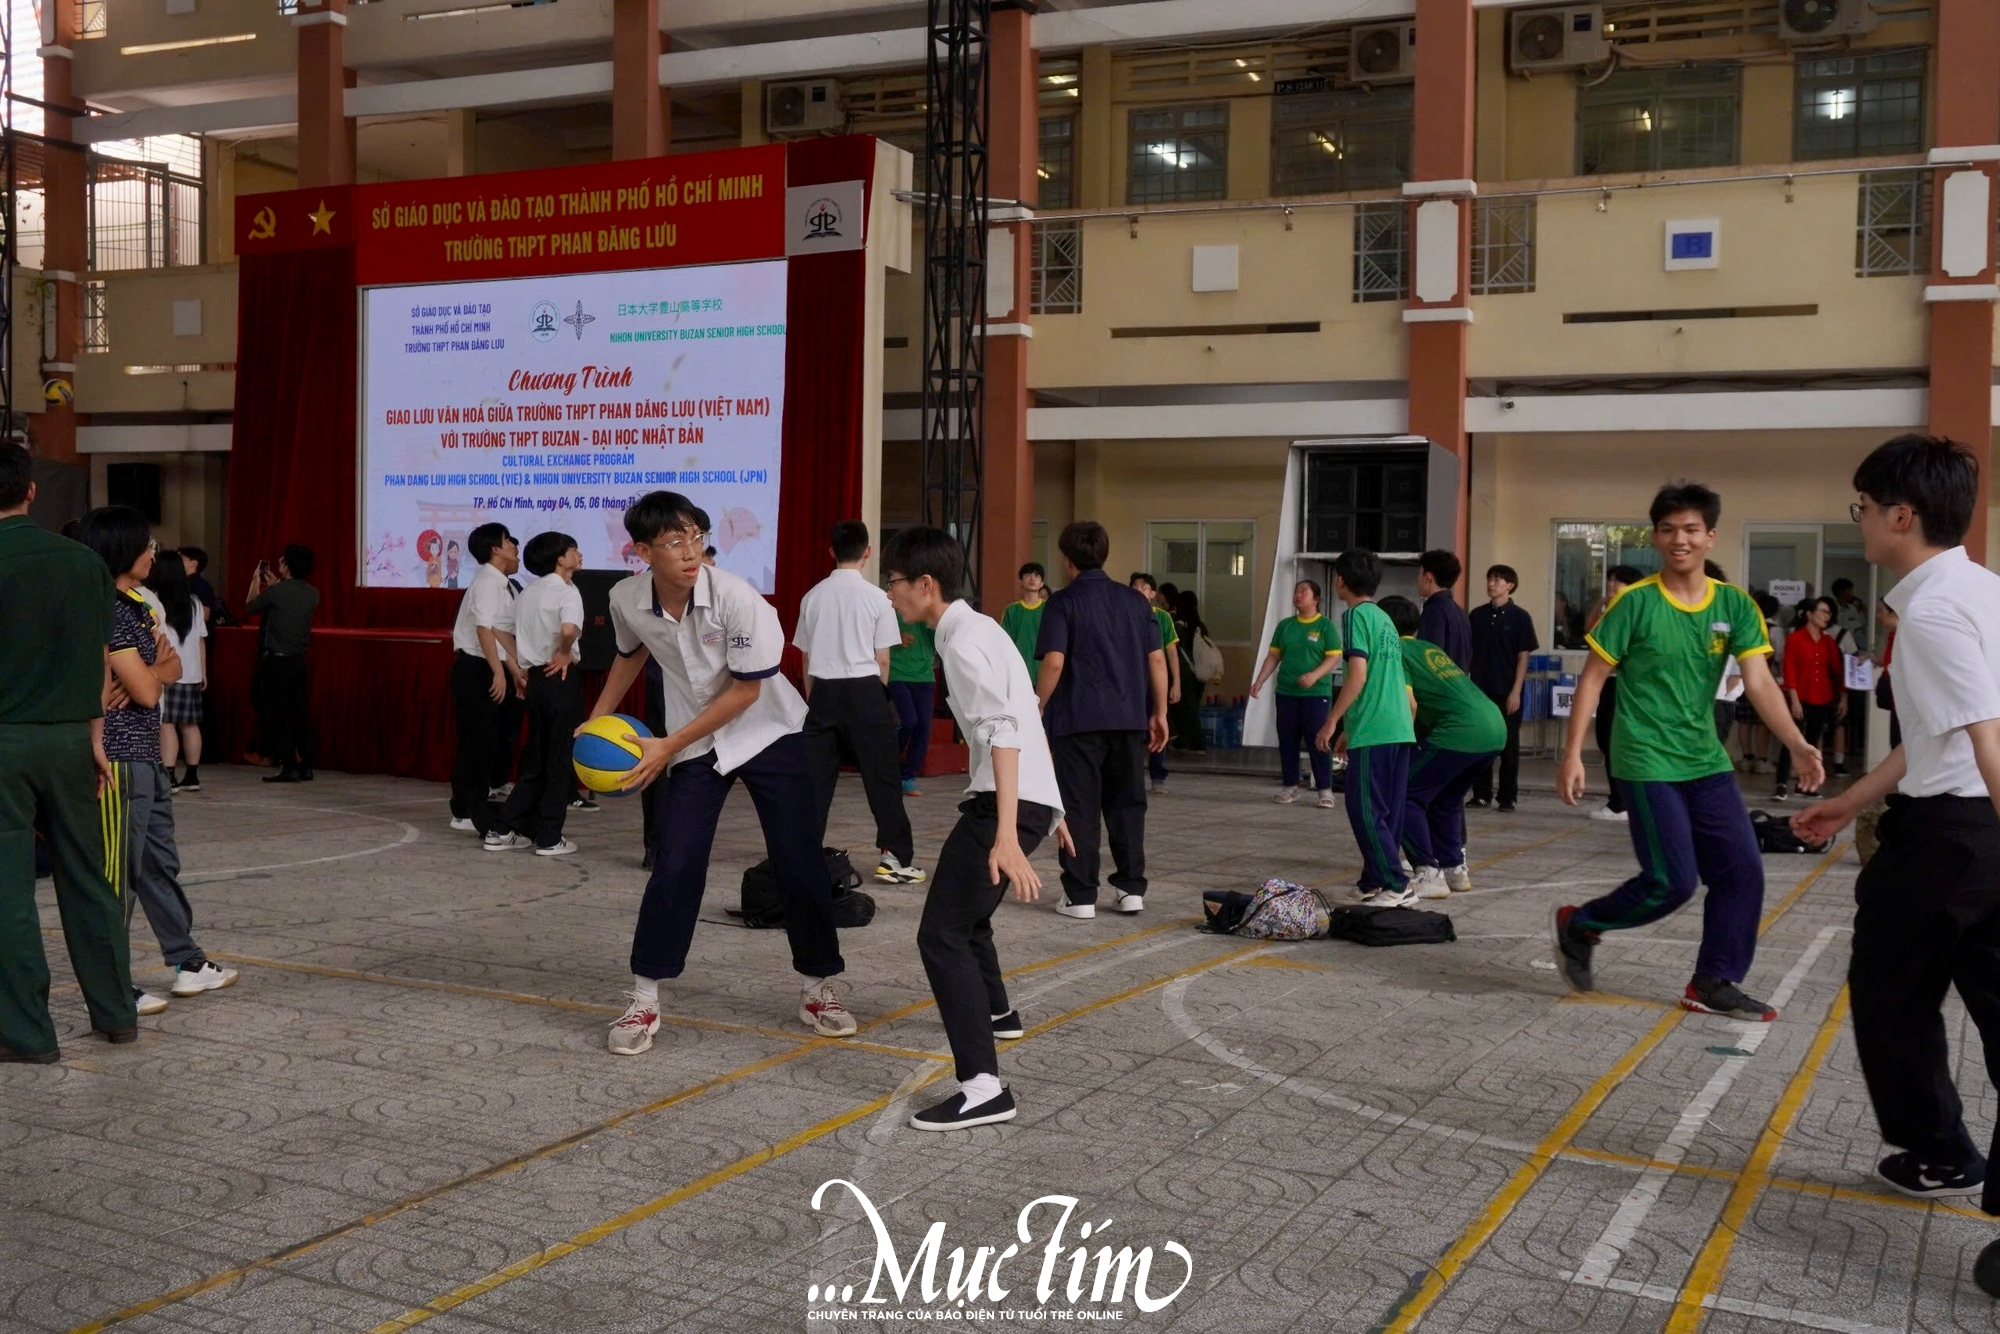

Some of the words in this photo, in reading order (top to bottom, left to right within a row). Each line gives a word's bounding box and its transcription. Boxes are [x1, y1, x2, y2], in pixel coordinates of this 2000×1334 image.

[395, 201, 427, 227] GIÁO
[433, 202, 462, 228] DỤC
[467, 196, 486, 222] VÀ
[490, 194, 520, 220] ĐÀO
[526, 195, 554, 221] TẠO
[560, 188, 611, 215] THÀNH
[618, 178, 649, 208] PHỐ
[656, 176, 677, 206] HỒ
[684, 175, 712, 204] CHÍ
[718, 174, 762, 201] MINH
[444, 234, 502, 262] TRƯỜNG
[508, 235, 546, 258] THPT
[552, 231, 592, 255] PHAN
[598, 226, 640, 252] ĐĂNG
[474, 322, 490, 332] MINH
[610, 332, 632, 342] NIHON
[635, 330, 677, 342] UNIVERSITY
[680, 329, 704, 339] BUZAN
[707, 327, 734, 338] SENIOR
[737, 326, 754, 336] HIGH
[757, 323, 786, 337] SCHOOL
[433, 342, 449, 351] THPT
[452, 341, 469, 350] PHAN
[509, 370, 576, 396] Chương
[582, 366, 632, 388] Trình
[387, 410, 410, 424] GIAO
[414, 408, 434, 424] LƯU
[438, 405, 459, 423] VĂN
[488, 403, 513, 422] GIỮA
[517, 402, 562, 421] TRƯỜNG
[566, 404, 596, 420] THPT
[600, 403, 631, 419] PHAN
[636, 398, 668, 418] ĐĂNG
[672, 398, 695, 417] LƯU
[699, 395, 732, 421] (VIỆT
[737, 397, 769, 416] NAM)
[442, 430, 458, 448] VỚI
[462, 429, 505, 448] TRƯỜNG
[510, 431, 538, 447] THPT
[542, 430, 579, 446] BUZAN
[592, 430, 611, 450] ĐẠI
[616, 429, 638, 450] HỌC
[642, 423, 674, 449] NHẬT
[679, 422, 703, 444] BẢN
[503, 455, 544, 466] CULTURAL
[548, 454, 591, 466] EXCHANGE
[594, 454, 634, 465] PROGRAM
[385, 475, 405, 485] PHAN
[408, 475, 428, 486] DANG
[431, 475, 446, 485] LUU
[448, 474, 466, 485] HIGH
[469, 474, 499, 485] SCHOOL
[502, 473, 522, 486] (VIE)
[524, 474, 530, 484] &
[534, 473, 559, 484] NIHON
[562, 472, 611, 484] UNIVERSITY
[614, 472, 642, 484] BUZAN
[645, 472, 676, 483] SENIOR
[680, 472, 700, 483] HIGH
[703, 471, 737, 483] SCHOOL
[740, 470, 766, 484] (JPN)
[474, 498, 484, 508] TP.
[488, 496, 498, 508] Hồ
[500, 497, 512, 508] Chí
[514, 497, 534, 509] Minh,
[537, 497, 556, 511] ngày
[559, 497, 571, 509] 04,
[574, 497, 586, 509] 05,
[589, 497, 599, 508] 06
[602, 496, 626, 511] tháng
